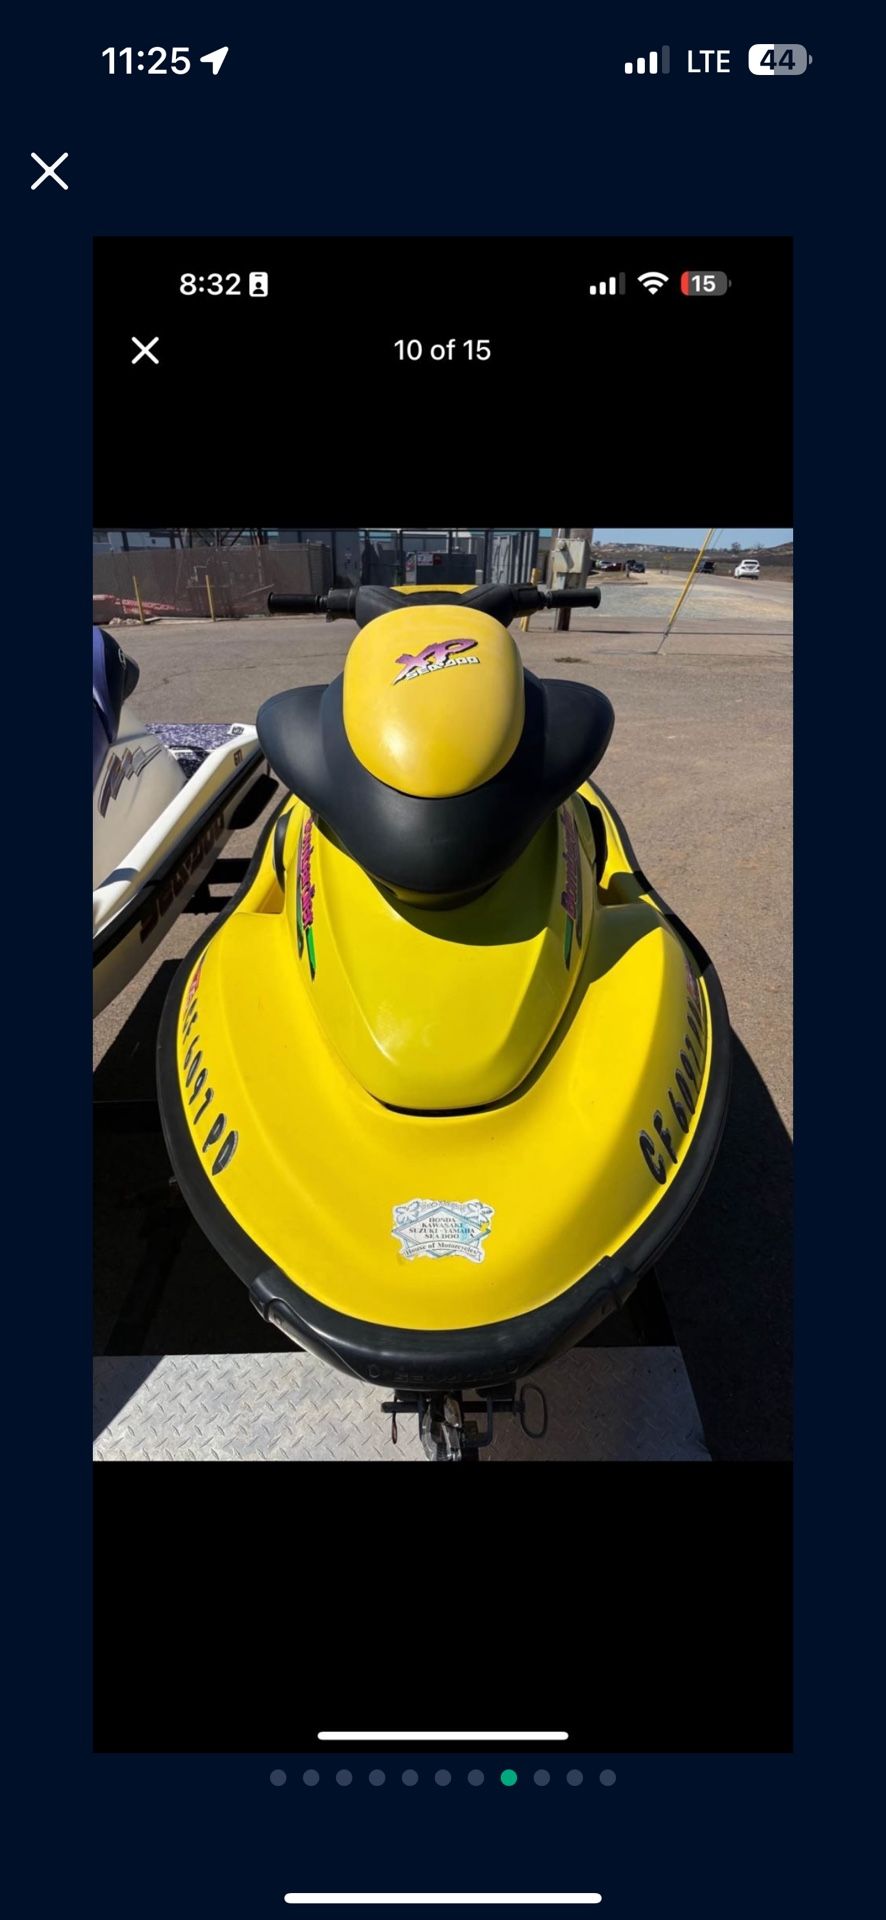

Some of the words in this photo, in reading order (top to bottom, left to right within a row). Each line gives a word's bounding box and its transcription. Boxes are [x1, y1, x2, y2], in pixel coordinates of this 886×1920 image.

[393, 638, 478, 685] XP
[184, 1034, 214, 1125] 6097
[202, 1113, 238, 1176] PD
[639, 1110, 678, 1185] CF
[405, 1245, 427, 1256] House
[437, 1242, 478, 1255] Motorcycles
